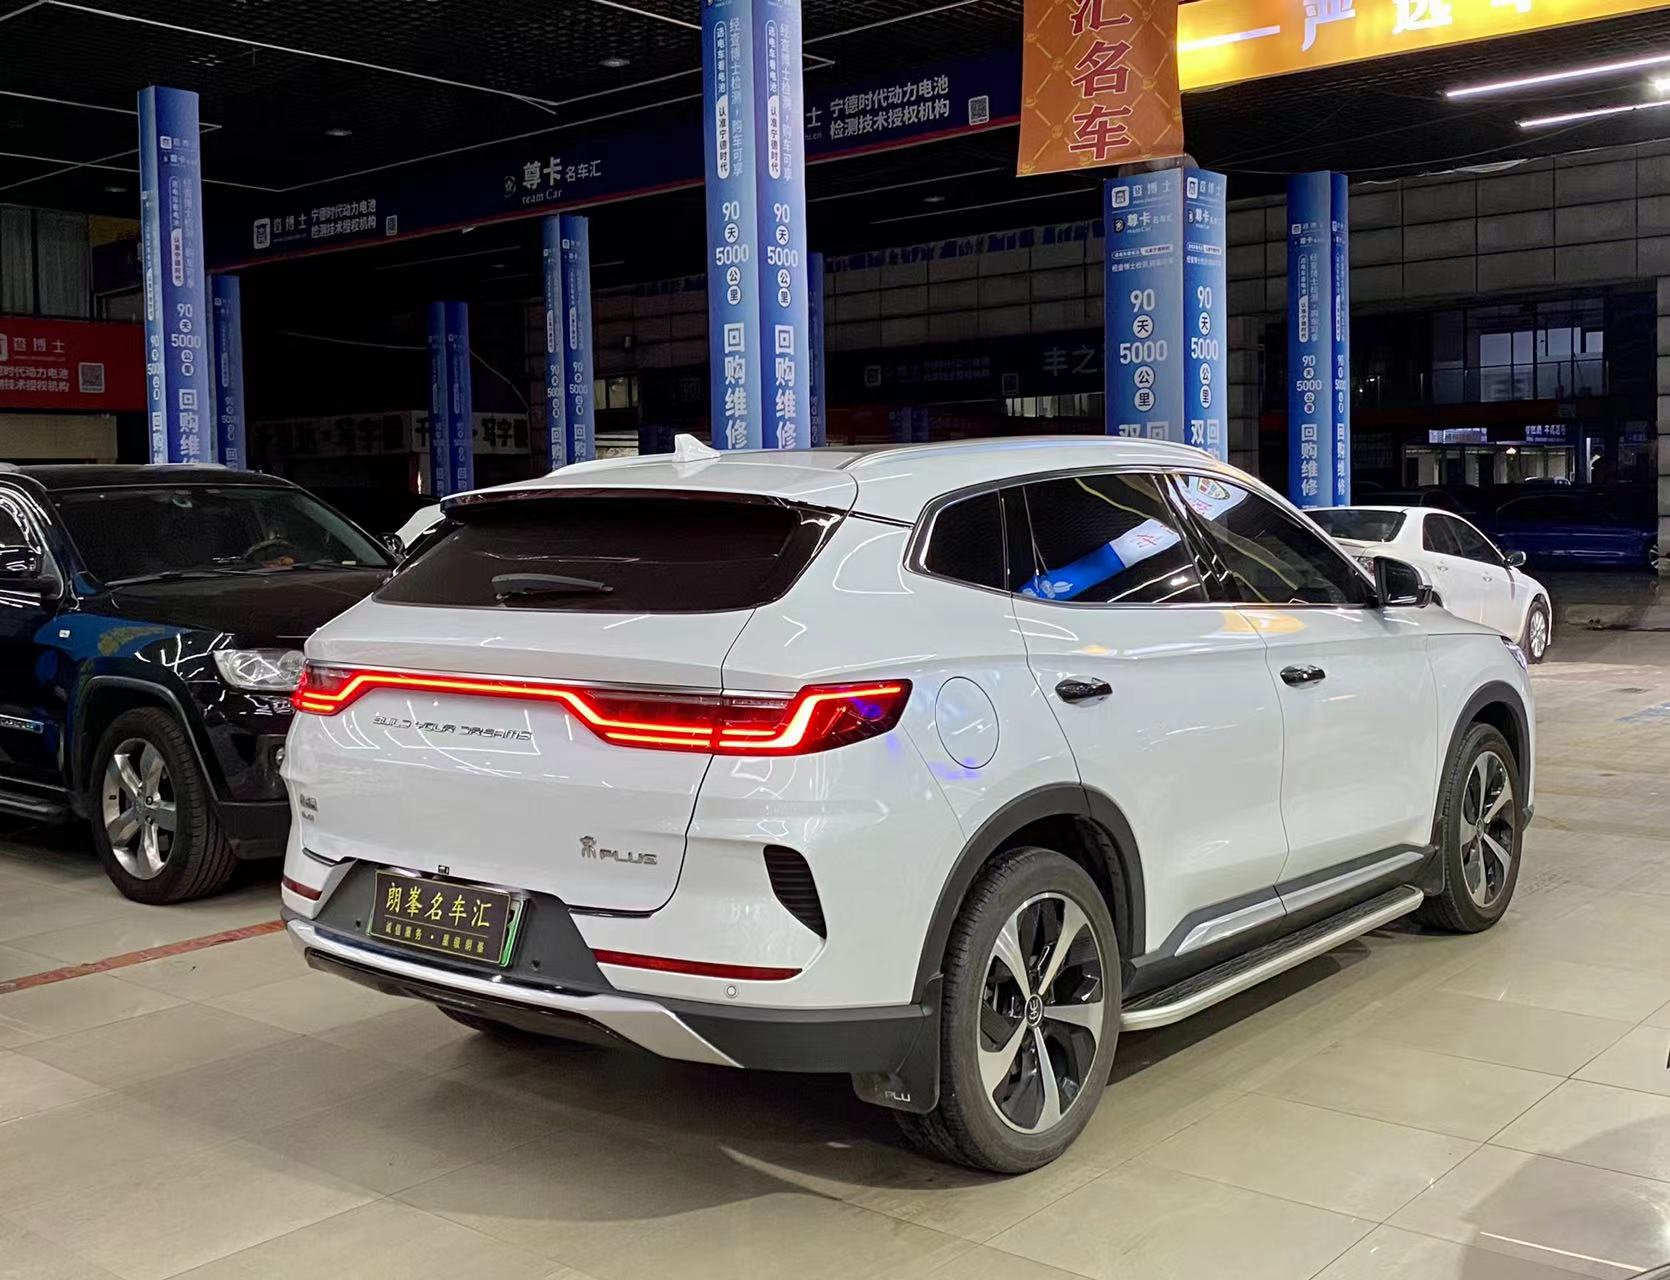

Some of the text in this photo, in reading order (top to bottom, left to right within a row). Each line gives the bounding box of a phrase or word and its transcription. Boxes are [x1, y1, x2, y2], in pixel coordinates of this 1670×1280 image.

[830, 74, 949, 117] 宁德时代动力电池
[830, 98, 950, 140] 检测技术授权机构
[522, 156, 602, 190] 尊卡 名车汇
[546, 189, 563, 200] Car
[311, 198, 377, 222] 宁德时代动力电池
[722, 201, 740, 221] 90
[773, 203, 790, 223] 90
[1127, 211, 1152, 227] 尊卡
[311, 215, 377, 238] 检测技术授权机构
[716, 244, 749, 266] 5000
[767, 246, 799, 267] 5000
[728, 268, 740, 304] 公里
[779, 270, 790, 305] 公里
[1197, 286, 1211, 309] 90
[177, 303, 193, 317] 90
[1130, 289, 1155, 312] 90
[171, 333, 202, 348] 5000
[1120, 340, 1168, 364] 5000
[1191, 338, 1219, 360] 5000
[573, 361, 583, 372] 90
[1302, 355, 1316, 366] 90
[569, 384, 588, 395] 5000
[724, 323, 747, 449] 回购维修
[775, 324, 796, 449] 回购维修
[1136, 368, 1153, 409] 公里
[1200, 365, 1211, 406] 公里
[1296, 380, 1322, 391] 5000
[179, 389, 201, 463] 回购维
[1301, 424, 1318, 496] 回购维修
[373, 715, 533, 741] BUILD YOUR DREAMS
[600, 849, 657, 865] PLUS
